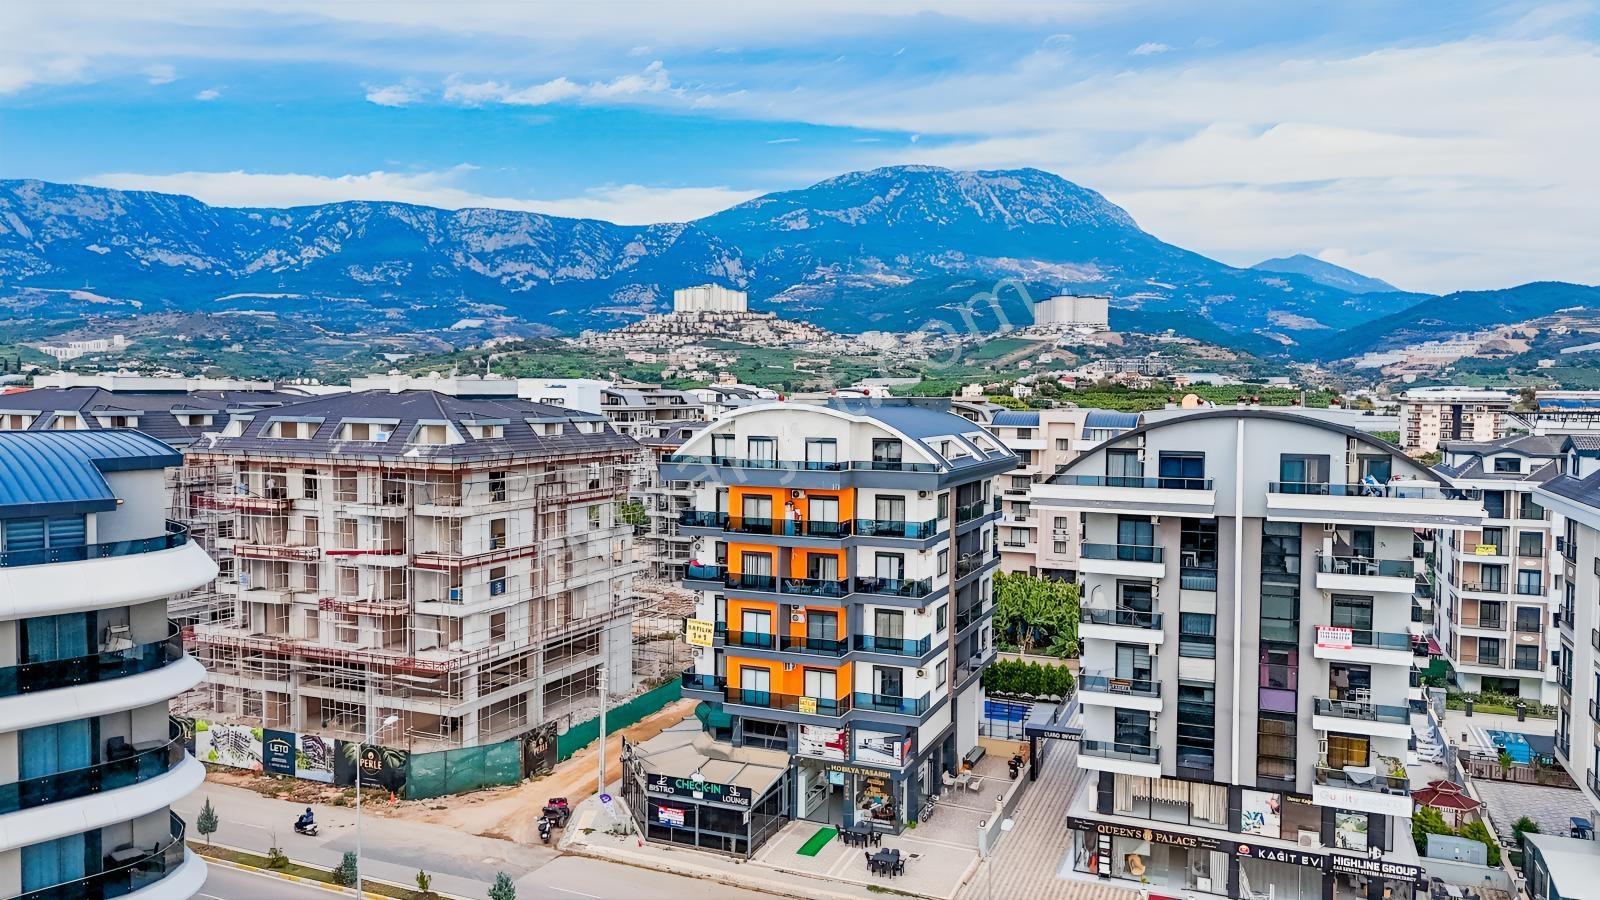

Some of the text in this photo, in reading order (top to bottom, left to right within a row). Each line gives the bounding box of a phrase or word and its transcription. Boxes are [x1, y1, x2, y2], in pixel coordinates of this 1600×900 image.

[270, 742, 289, 754] LETO
[360, 758, 382, 770] PERLE
[648, 783, 675, 794] BISTRO
[675, 779, 721, 795] CHECK-IN
[722, 795, 749, 806] LOUNGE
[1097, 824, 1142, 839] QUEEN'S
[1156, 833, 1197, 847] PALACE
[1333, 856, 1418, 876] HIGHLINE GROUP
